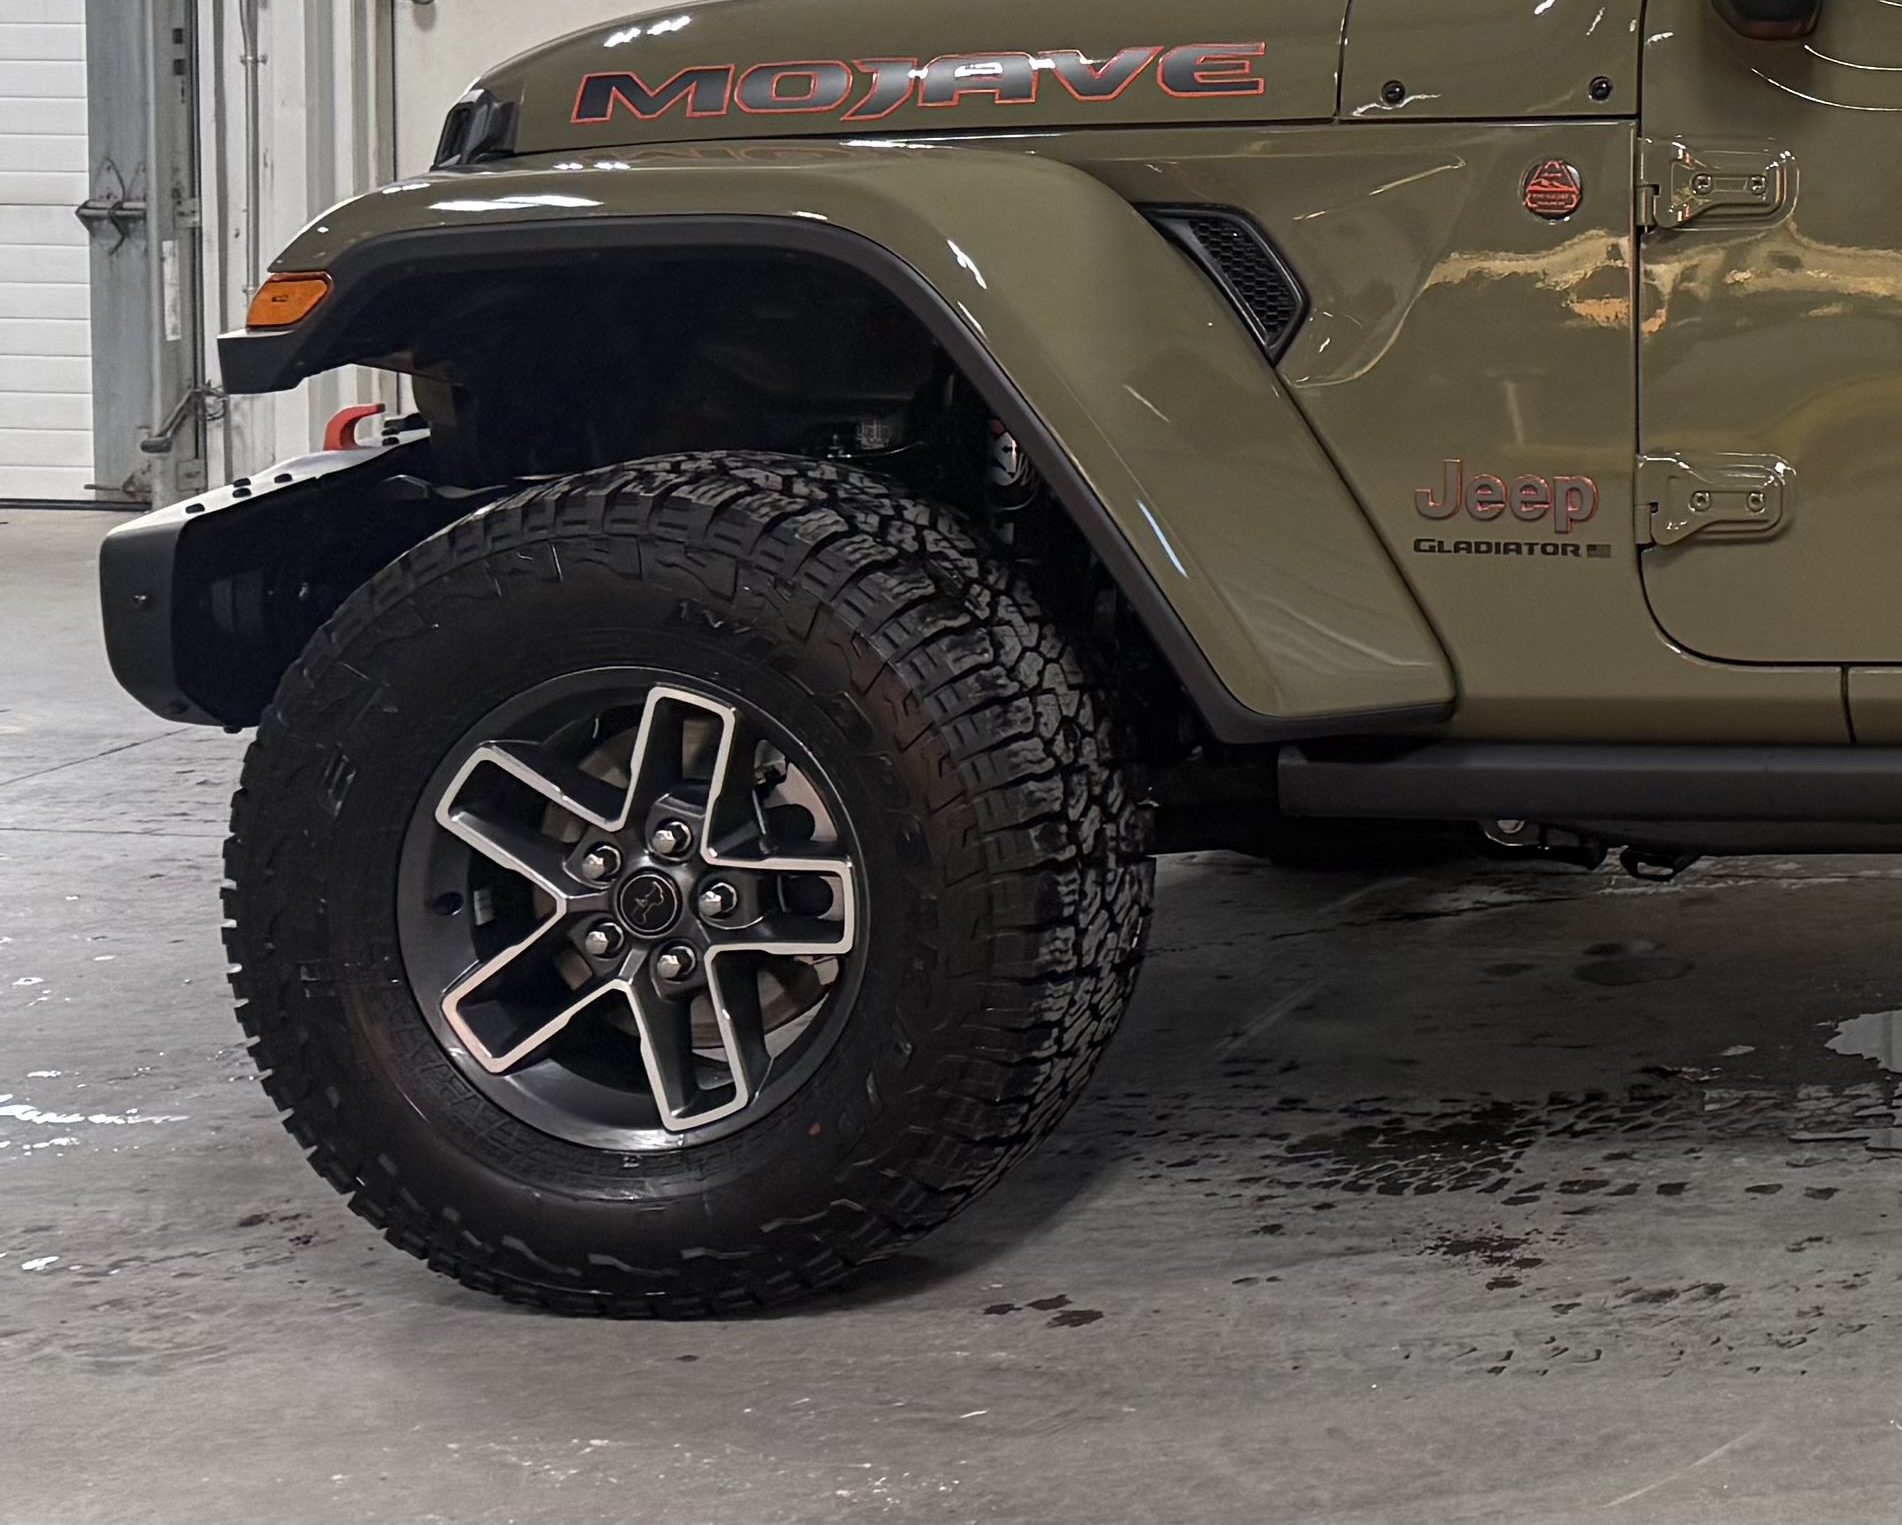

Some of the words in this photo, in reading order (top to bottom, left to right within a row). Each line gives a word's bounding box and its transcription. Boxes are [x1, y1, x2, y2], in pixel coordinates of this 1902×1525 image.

[570, 41, 1266, 122] MOJAVE
[1413, 458, 1600, 534] Jeep
[1413, 538, 1582, 558] GLADIATOR
